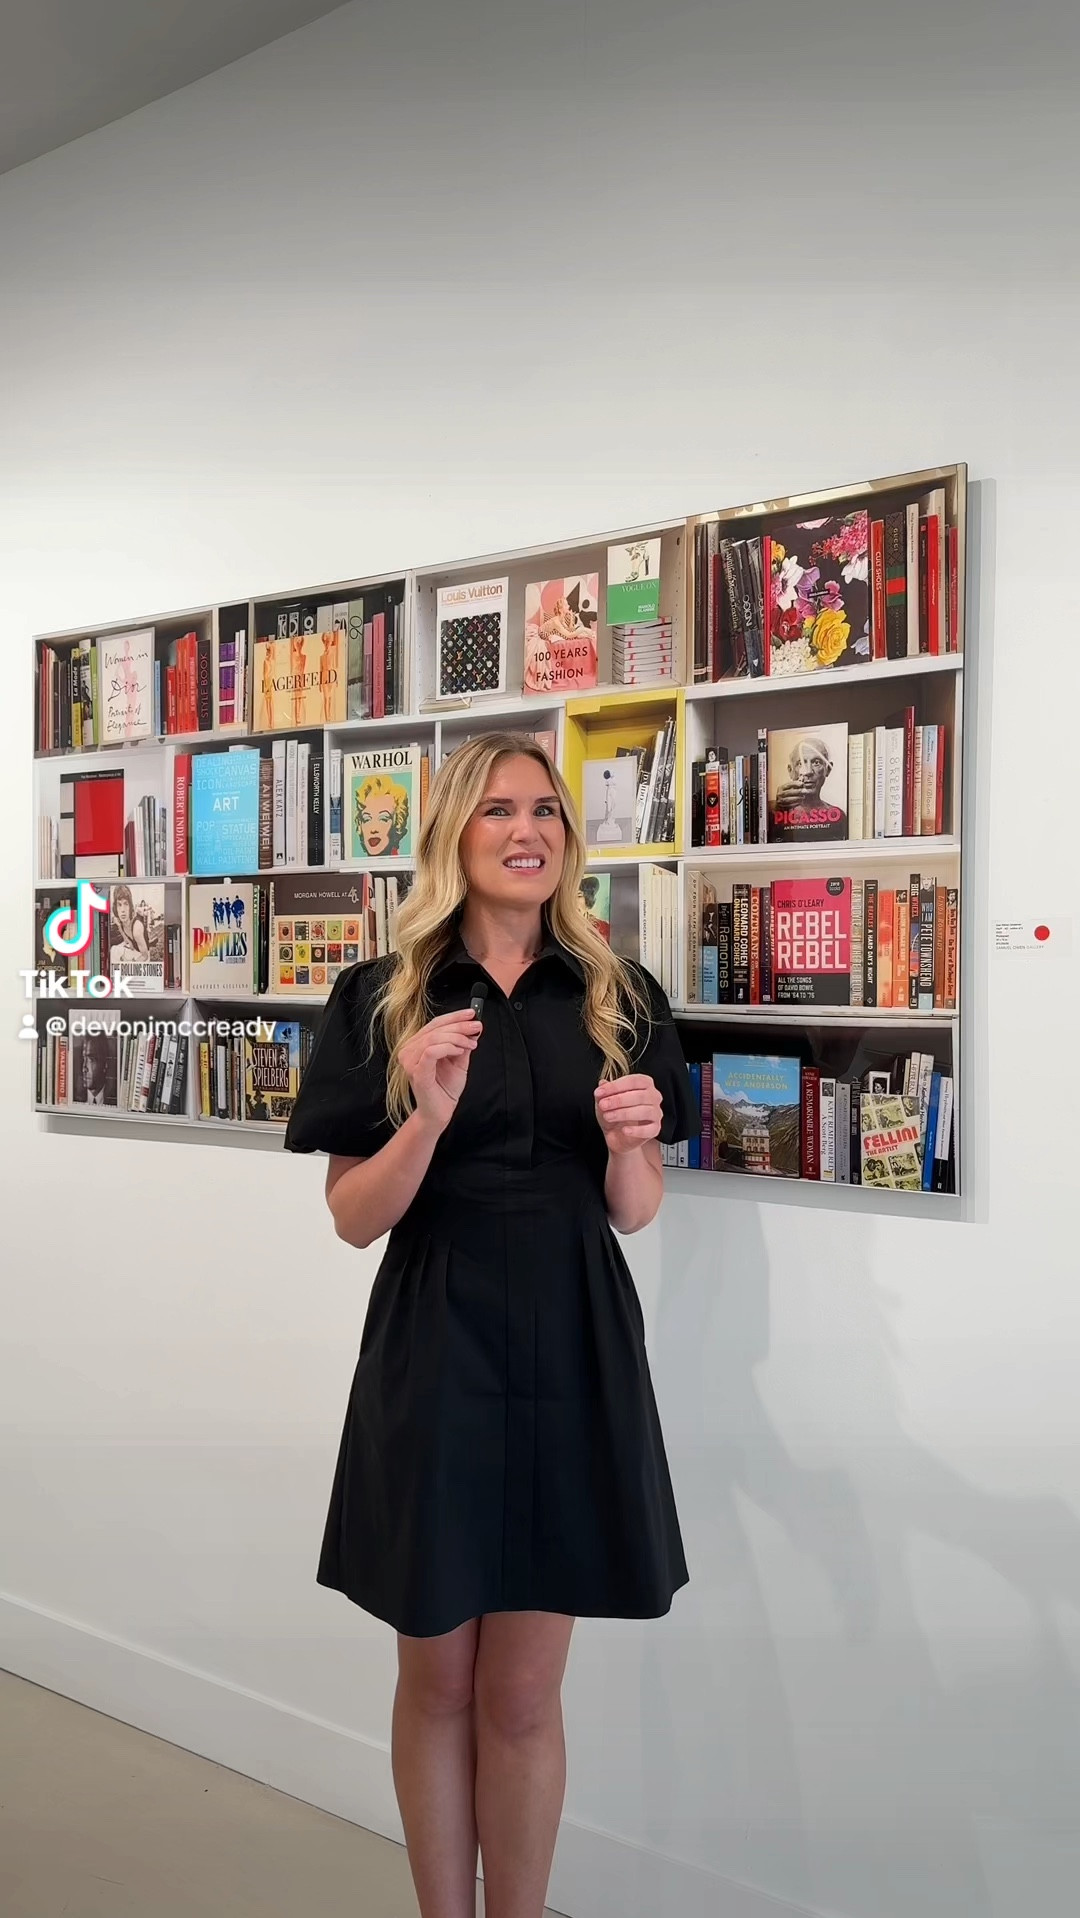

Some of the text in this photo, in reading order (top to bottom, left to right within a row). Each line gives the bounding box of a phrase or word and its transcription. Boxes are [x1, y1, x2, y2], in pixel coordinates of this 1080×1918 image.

[441, 587, 466, 604] Louis
[469, 584, 503, 600] Vuitton
[622, 583, 644, 593] VOGUE
[105, 650, 134, 669] Women
[534, 646, 588, 662] 100 YEARS
[261, 669, 338, 693] LAGERFELD
[536, 668, 584, 682] FASHION
[73, 689, 78, 697] La
[201, 689, 209, 718] STYLE
[351, 751, 412, 769] WARHOL
[218, 764, 256, 777] CANVAS
[213, 796, 240, 812] ART
[176, 776, 185, 855] ROBERT INDIANA
[261, 784, 270, 849] AI WEIWEI
[773, 806, 841, 825] PICASSO
[197, 821, 256, 834] POP STATUE
[777, 898, 825, 909] CHRIS O'LEARY
[740, 898, 748, 966] LEONARD COHEN
[751, 896, 759, 960] COLTRANE
[777, 910, 847, 940] REBEL
[192, 928, 247, 963] BEATLES
[777, 939, 847, 969] REBEL
[719, 926, 729, 988] Ramones
[920, 924, 933, 987] PETE TOWNSHEND
[121, 963, 142, 976] ROLLING
[143, 963, 162, 976] STONES
[253, 1048, 277, 1067] STEVEN
[253, 1067, 289, 1088] SPIELBERG
[725, 1080, 788, 1090] WES ANDERSON
[728, 1072, 786, 1083] ACCIDENTALLY
[863, 1126, 918, 1152] FELLINI
[806, 1136, 814, 1164] WOMAN
[878, 1146, 898, 1154] ARTIST
